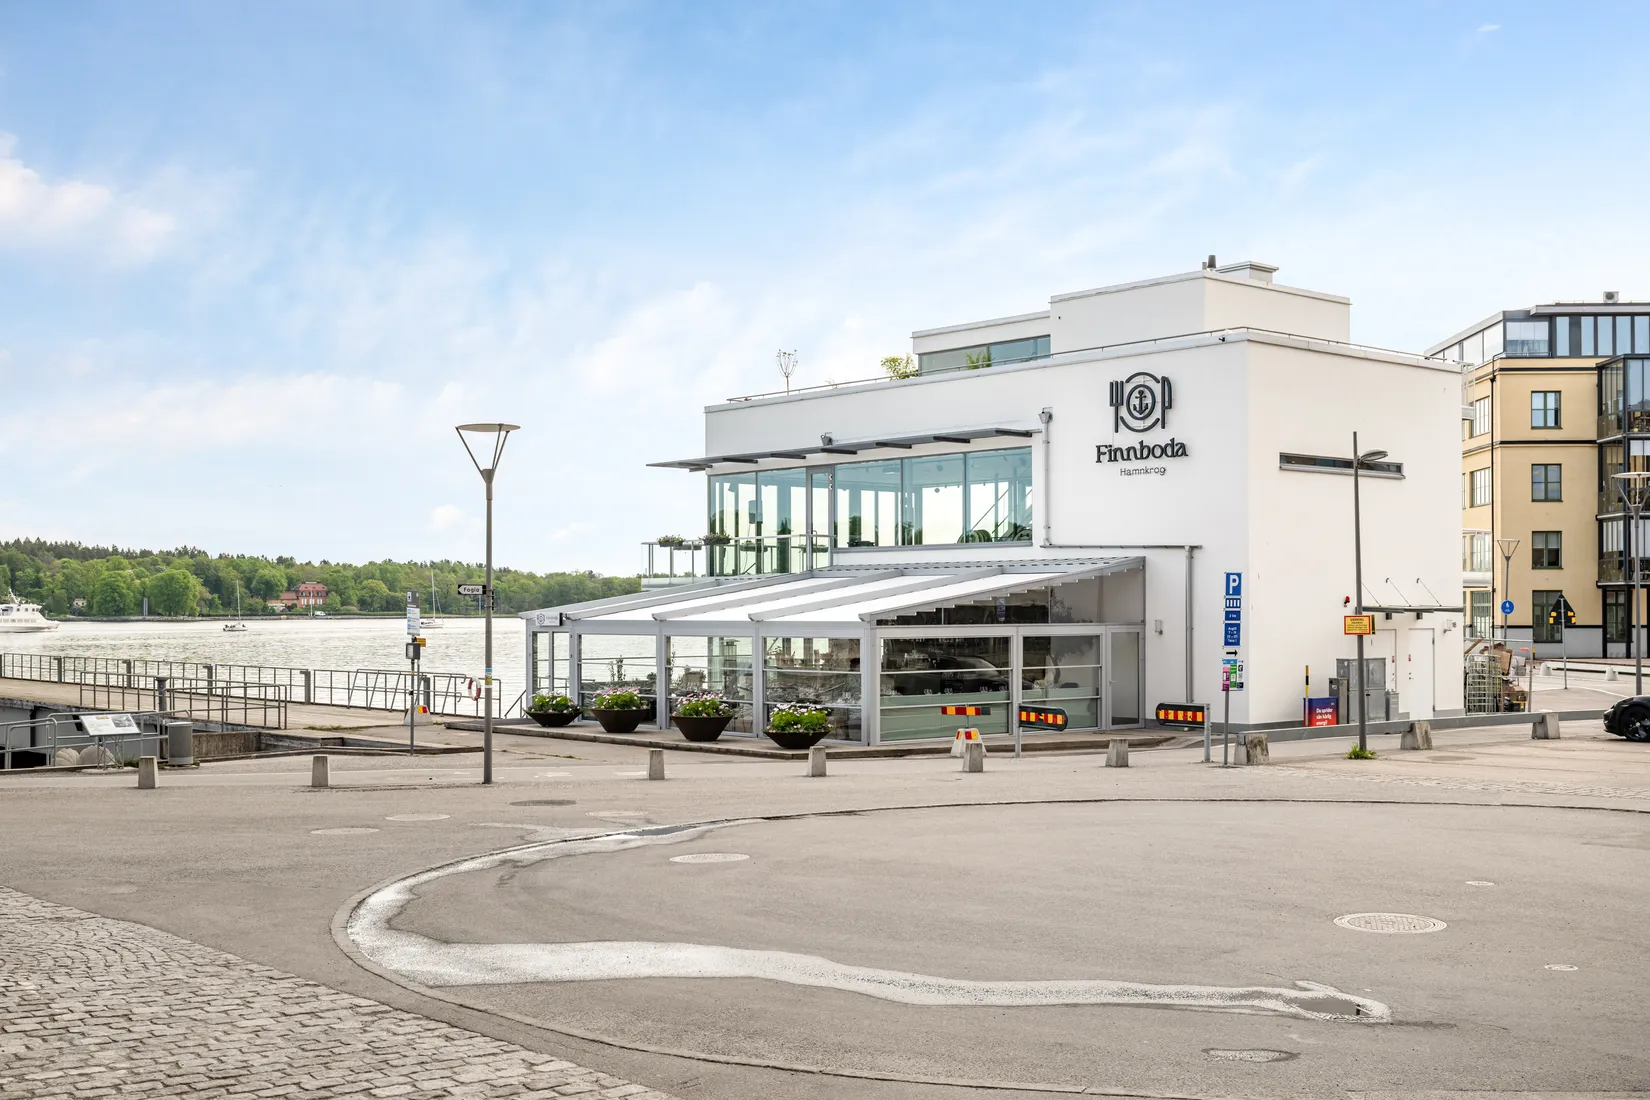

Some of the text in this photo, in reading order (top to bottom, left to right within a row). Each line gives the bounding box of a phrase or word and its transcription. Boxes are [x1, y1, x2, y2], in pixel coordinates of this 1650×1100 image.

[1095, 437, 1189, 463] Finnboda
[1120, 466, 1166, 476] Hamnkrog
[1230, 574, 1240, 594] P
